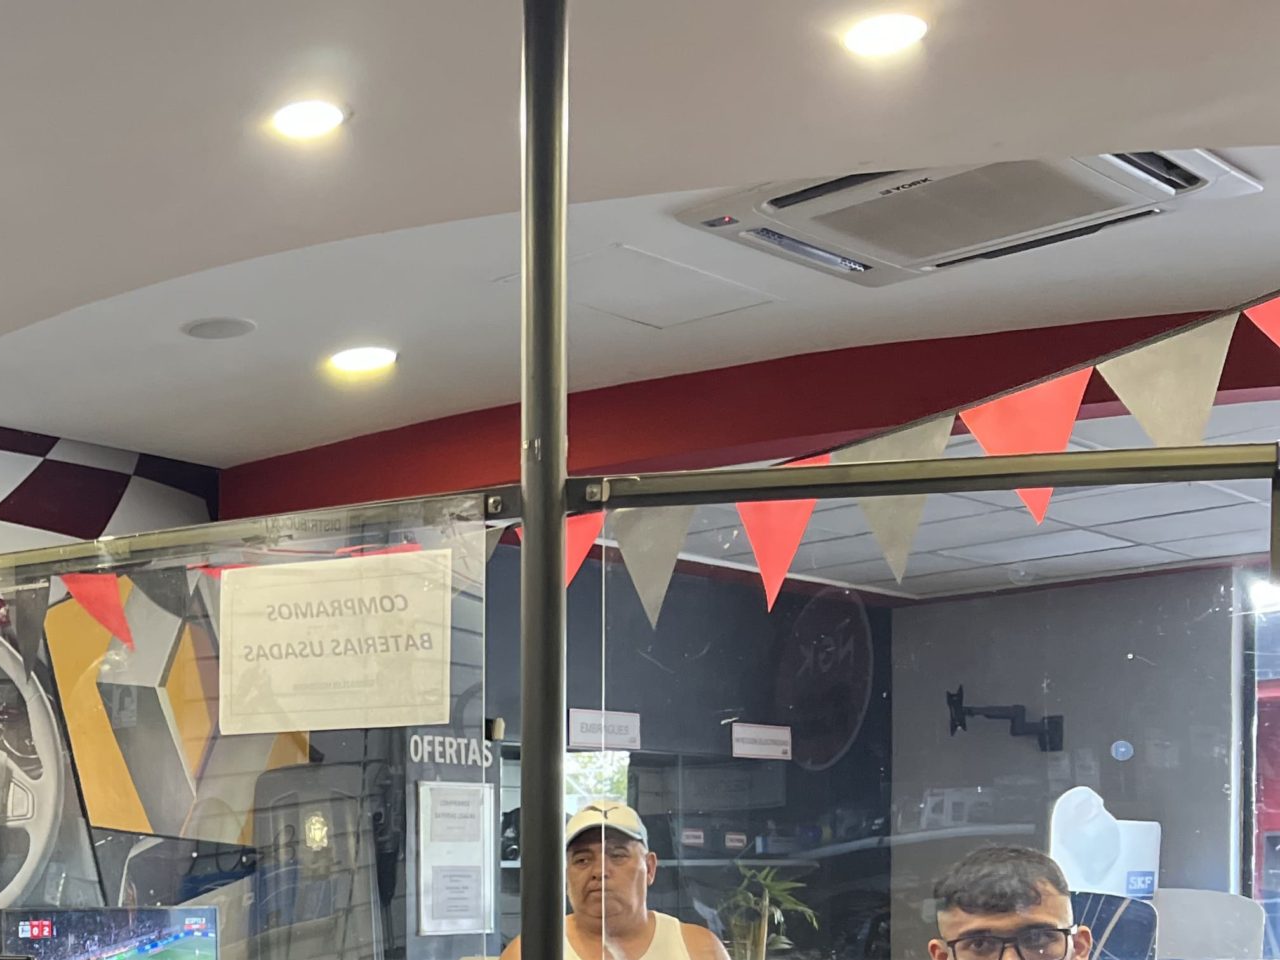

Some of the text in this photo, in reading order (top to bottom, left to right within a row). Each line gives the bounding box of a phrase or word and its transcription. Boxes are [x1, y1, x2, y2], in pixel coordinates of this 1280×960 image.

[891, 177, 933, 191] YORK
[409, 734, 493, 768] OFERTAS
[1128, 876, 1153, 889] SKF
[32, 926, 50, 936] 0 2
